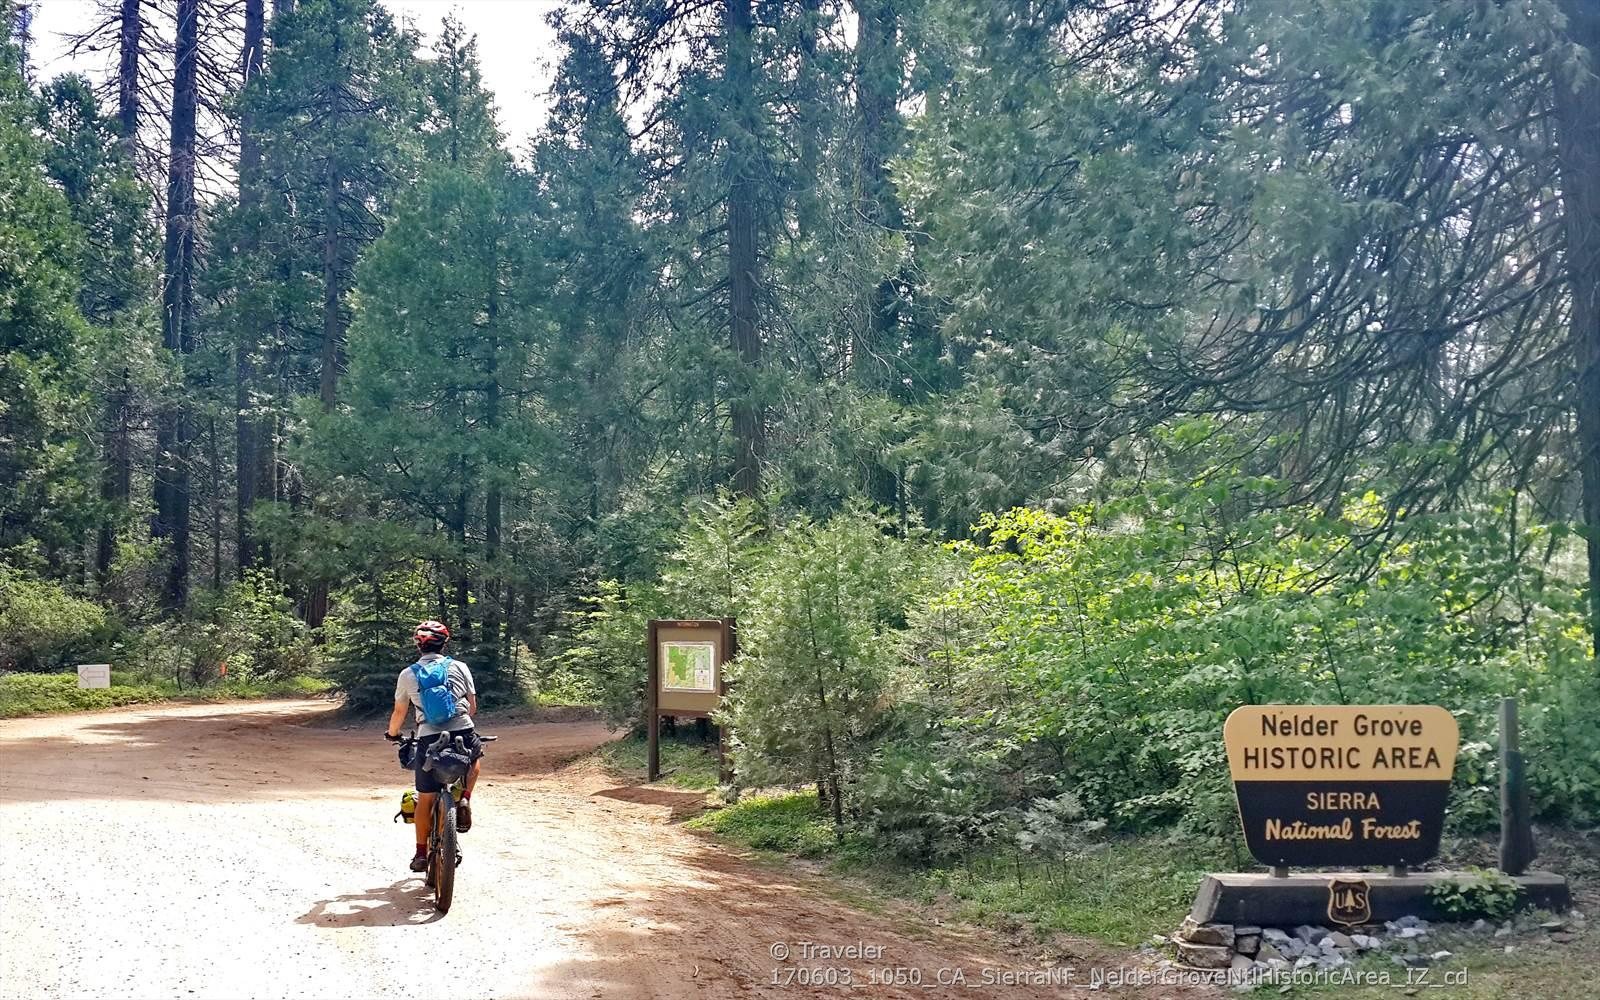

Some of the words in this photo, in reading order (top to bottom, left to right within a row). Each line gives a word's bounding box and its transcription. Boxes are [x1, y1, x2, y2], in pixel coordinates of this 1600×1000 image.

[1261, 714, 1339, 737] Nelder
[1353, 714, 1423, 737] Grove
[1243, 746, 1361, 770] HISTORIC
[1372, 746, 1441, 769] AREA
[1306, 791, 1381, 811] SIERRA
[1264, 817, 1353, 841] National
[1360, 817, 1422, 840] Forest
